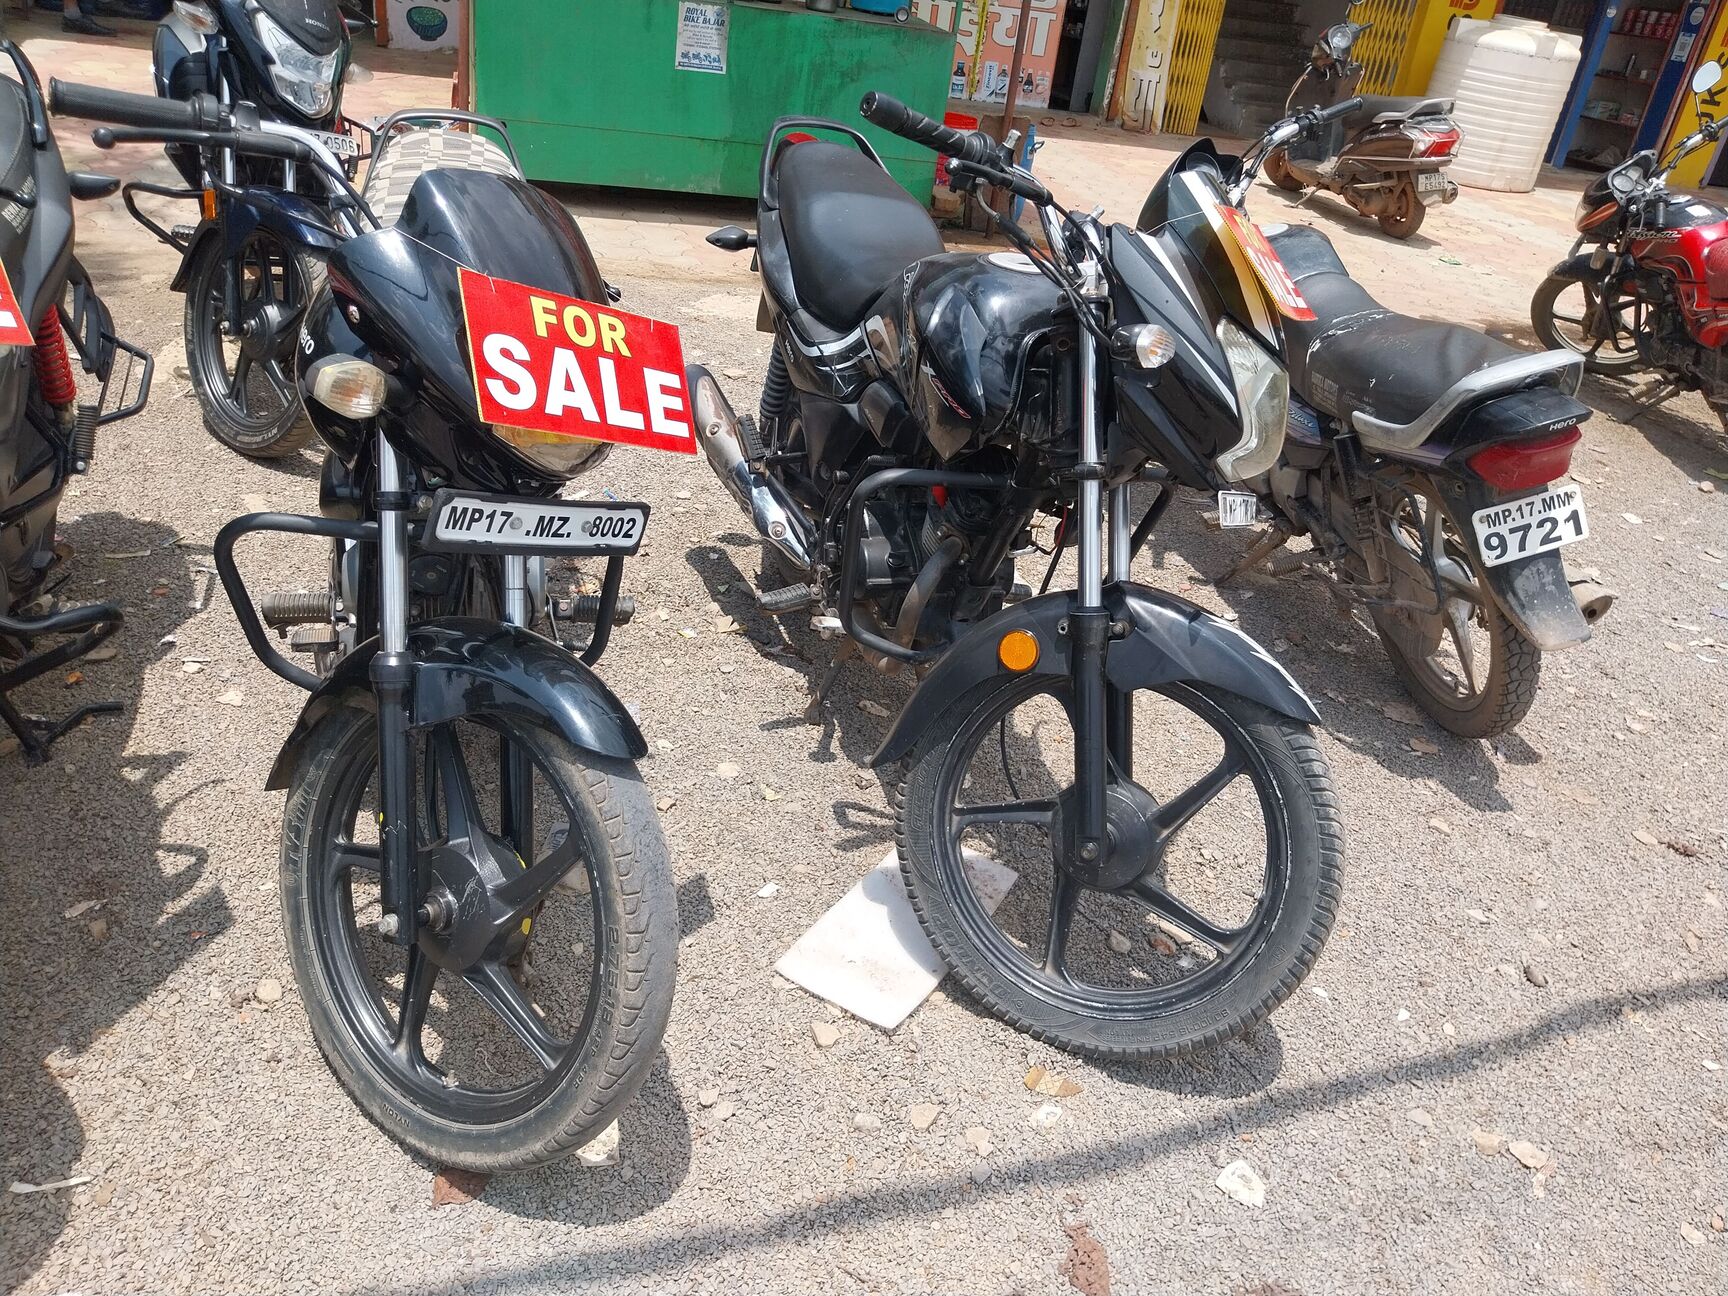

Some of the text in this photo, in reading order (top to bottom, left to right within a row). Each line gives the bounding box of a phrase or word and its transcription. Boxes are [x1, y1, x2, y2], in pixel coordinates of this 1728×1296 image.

[683, 15, 701, 24] BIKE
[685, 7, 707, 17] ROYAL
[326, 135, 355, 153] 0506
[529, 295, 632, 358] FOR
[482, 333, 690, 438] SALE
[444, 505, 514, 534] MP17
[588, 515, 637, 540] 8002
[1483, 508, 1584, 561] 9721
